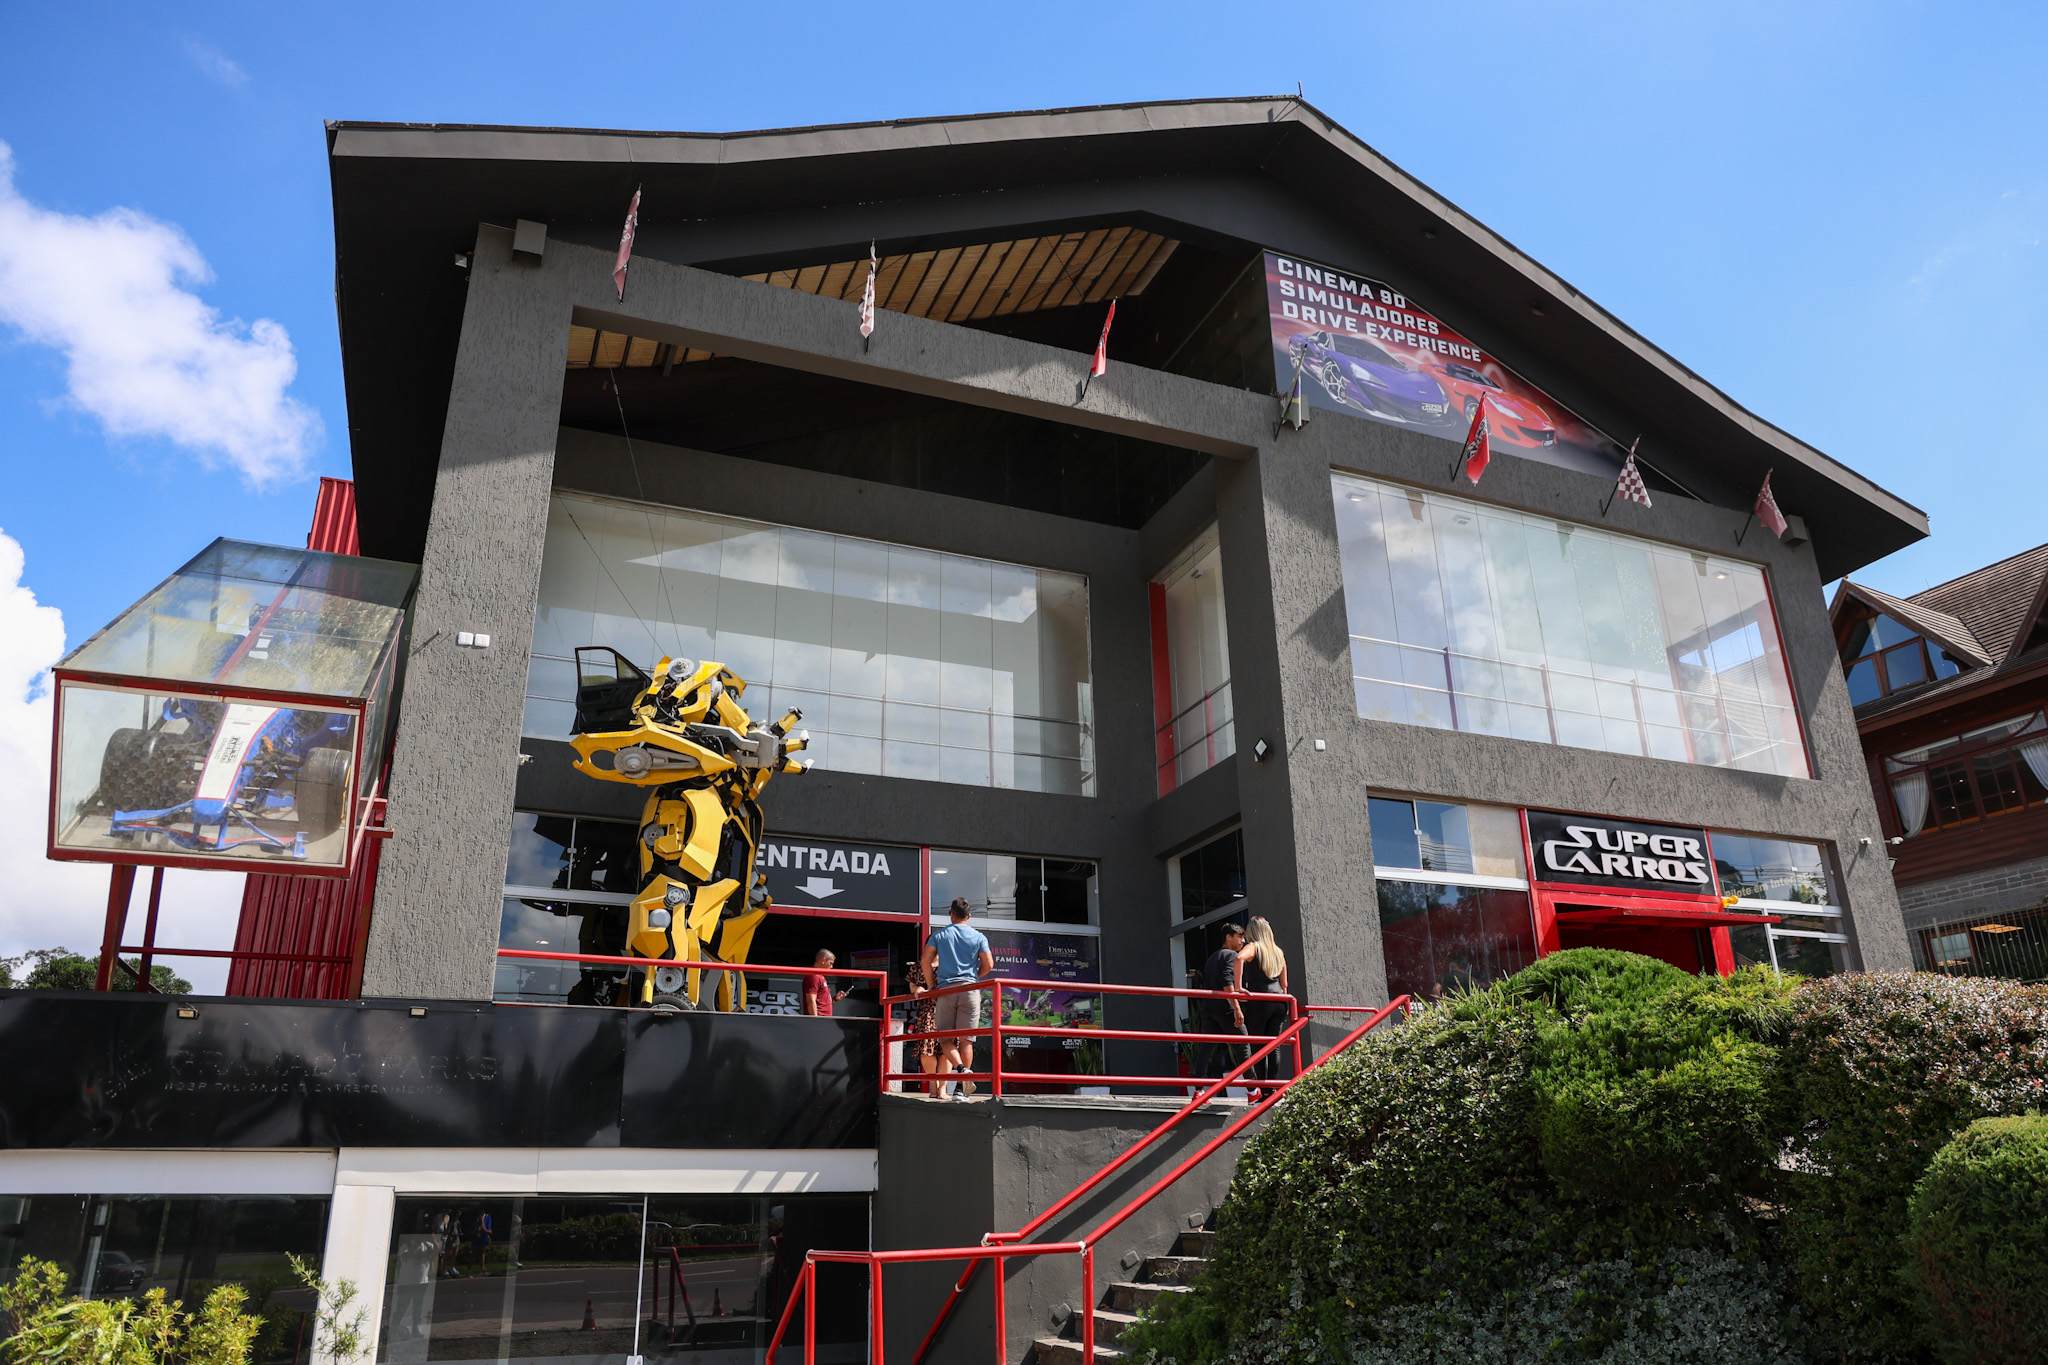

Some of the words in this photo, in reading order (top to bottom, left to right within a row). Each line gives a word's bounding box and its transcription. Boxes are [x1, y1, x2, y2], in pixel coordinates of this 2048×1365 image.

[1278, 258, 1374, 300] CINEMA
[1380, 289, 1406, 309] 9D
[1280, 279, 1439, 335] SIMULADORES
[1282, 300, 1358, 333] DRIVE
[1365, 321, 1482, 362] EXPERIENCE
[755, 843, 891, 876] ENTRADA
[1565, 825, 1705, 860] SUPER
[1543, 839, 1709, 884] CARROS
[1753, 882, 1769, 895] em
[990, 947, 1021, 956] ARANTIDA
[995, 955, 1029, 964] FAMÍLIA
